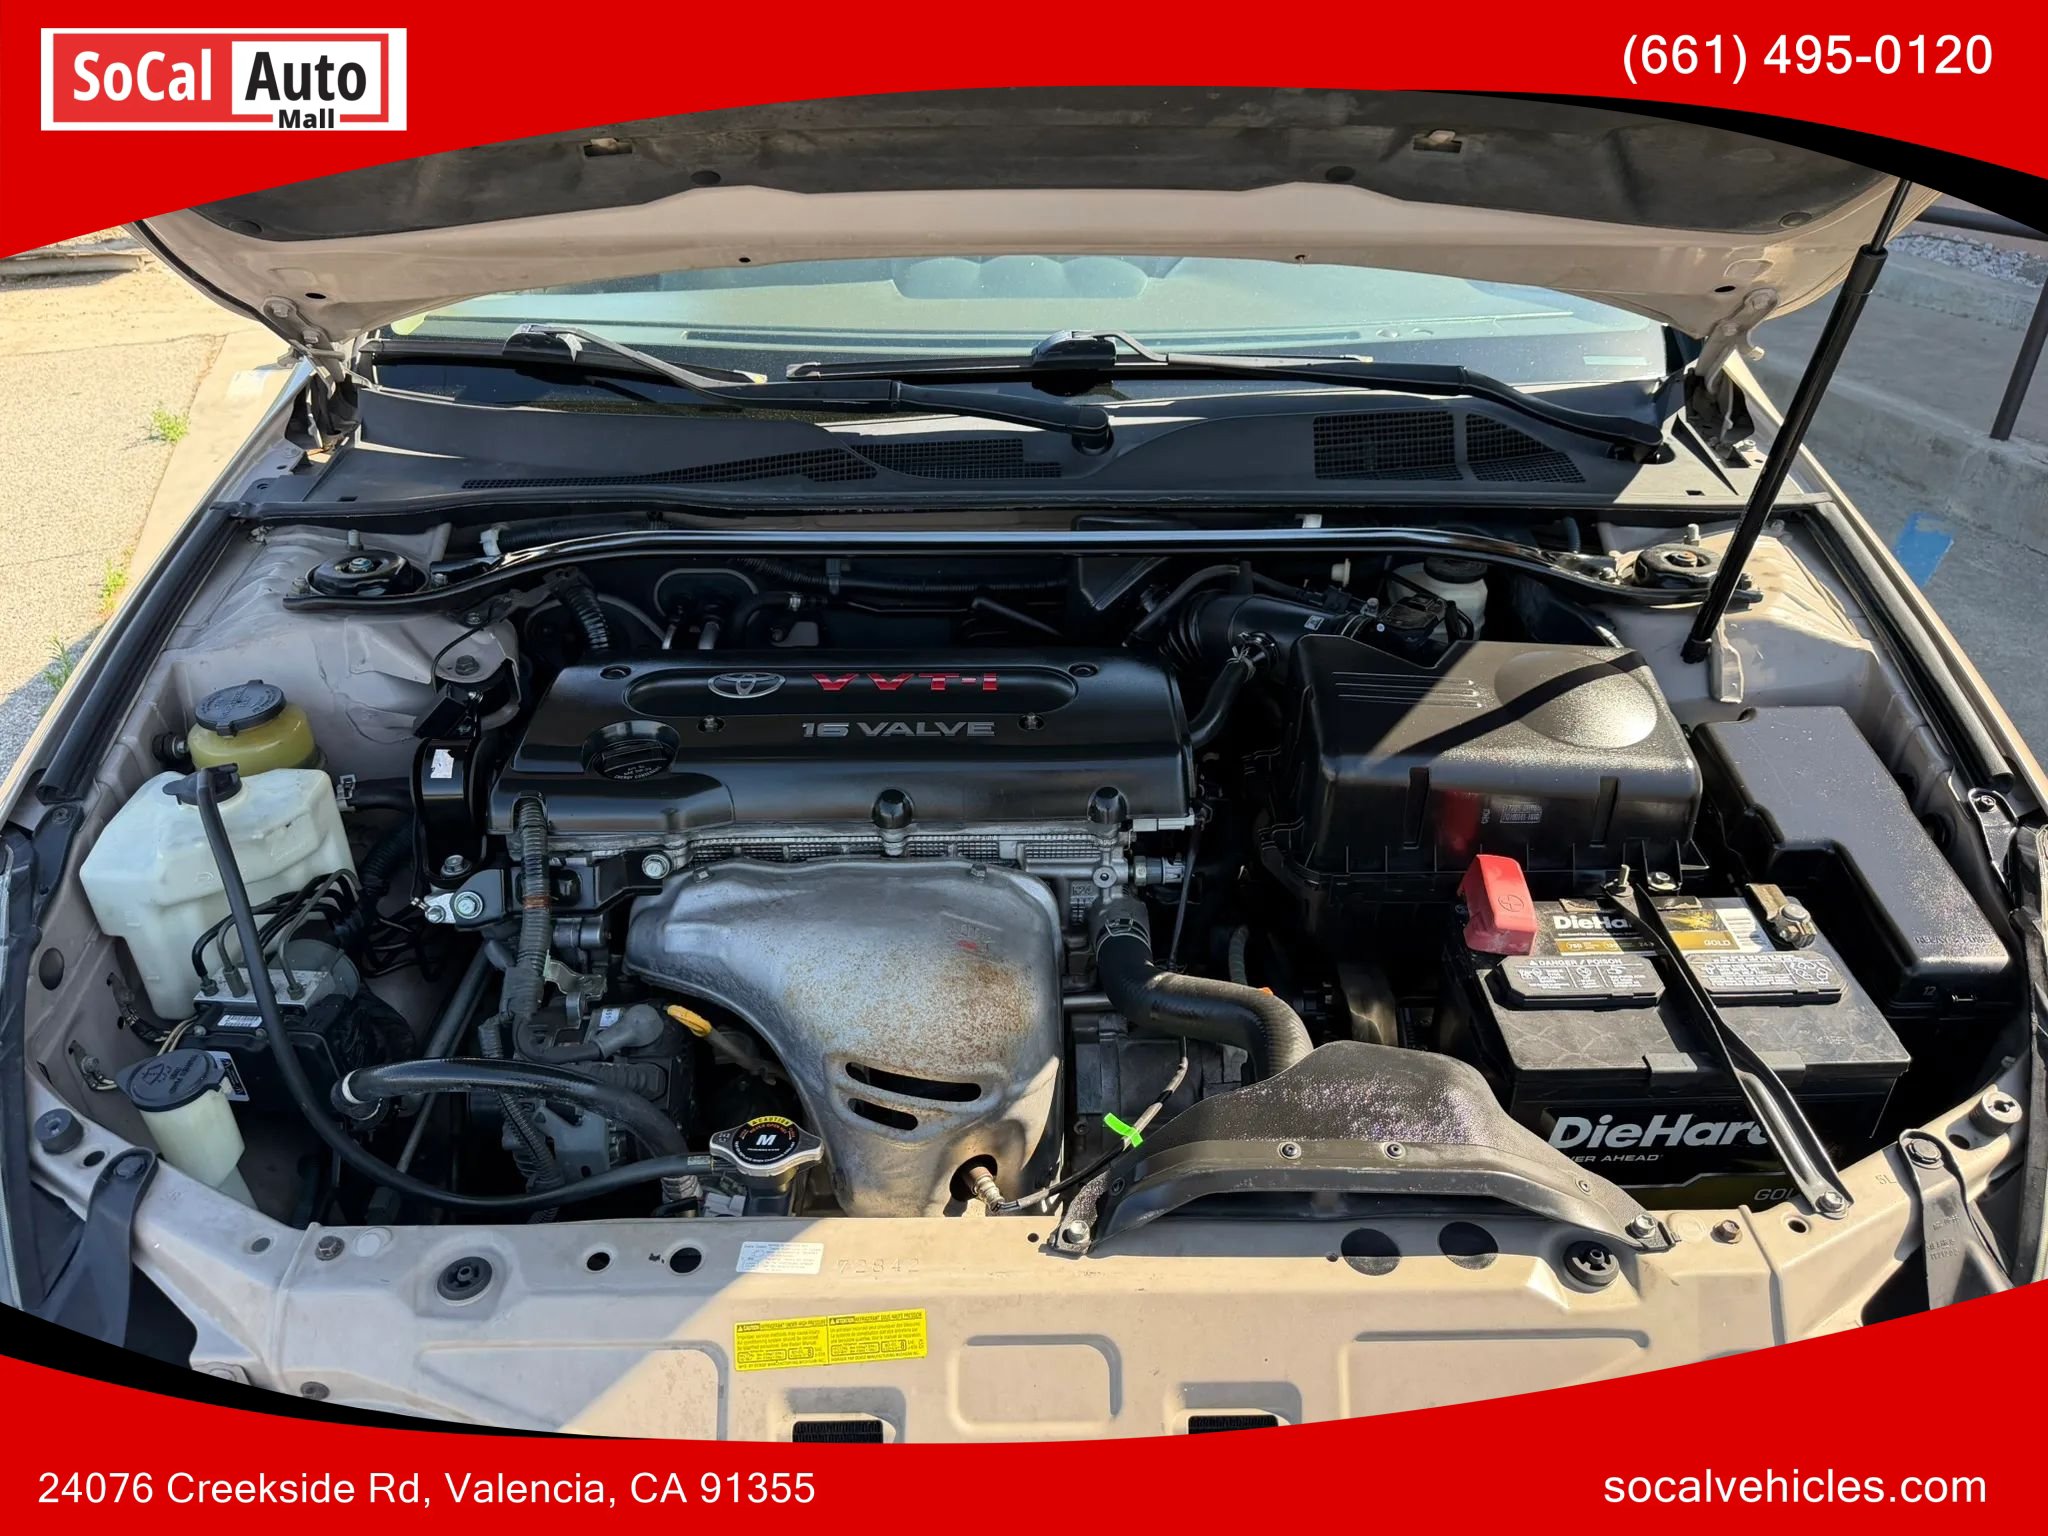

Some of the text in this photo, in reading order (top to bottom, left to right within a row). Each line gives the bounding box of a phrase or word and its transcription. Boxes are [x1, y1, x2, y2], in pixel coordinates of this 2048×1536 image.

[802, 721, 996, 738] 16 VALVE
[1539, 959, 1577, 967] DANGER
[1587, 958, 1623, 966] POISON
[756, 1134, 777, 1146] M
[1600, 1154, 1659, 1163] AHEAD
